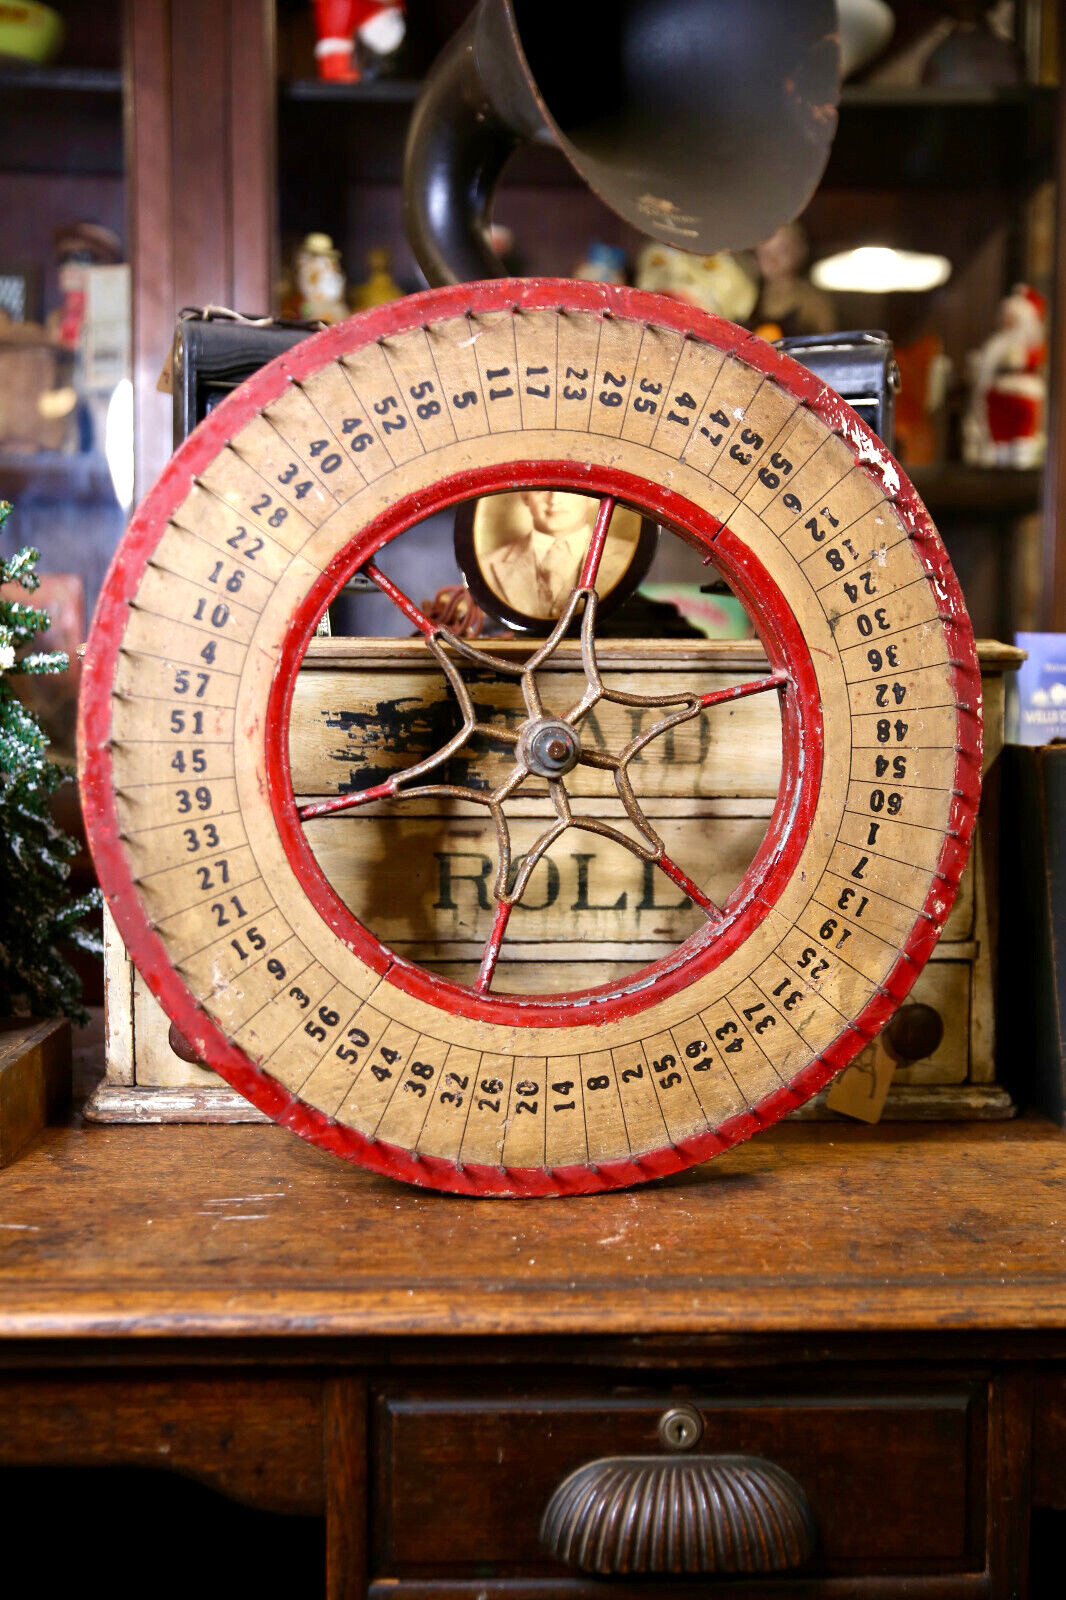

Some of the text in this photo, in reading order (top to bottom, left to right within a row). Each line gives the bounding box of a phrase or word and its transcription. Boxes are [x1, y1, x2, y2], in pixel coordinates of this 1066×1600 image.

[486, 367, 514, 401] 11
[526, 366, 550, 399] 17
[563, 367, 588, 401] 23
[599, 371, 627, 408] 29
[633, 378, 662, 415] 35
[374, 396, 406, 435] 52
[410, 381, 441, 420] 58
[452, 389, 478, 410] 5
[666, 392, 697, 427] 41
[341, 418, 373, 452] 46
[700, 409, 731, 447] 47
[310, 440, 342, 474] 40
[729, 428, 764, 466] 53
[278, 463, 313, 499] 34
[757, 452, 793, 490] 59
[252, 493, 287, 529] 28
[783, 493, 804, 514] 6
[804, 506, 840, 542] 12
[227, 525, 264, 561] 22
[825, 537, 859, 572] 18
[208, 562, 245, 593] 16
[843, 571, 877, 604] 24
[193, 598, 230, 629] 10
[856, 606, 891, 637] 30
[200, 640, 217, 666] 4
[867, 644, 898, 673] 36
[174, 670, 210, 698] 57
[875, 682, 907, 708] 42
[171, 710, 202, 735] 51
[876, 718, 909, 743] 48
[171, 749, 206, 773] 45
[875, 754, 907, 779] 54
[175, 786, 212, 813] 39
[869, 789, 902, 816] 60
[183, 823, 219, 852] 33
[867, 823, 880, 846] 1
[196, 860, 229, 891] 27
[433, 852, 693, 911] ROLL
[851, 856, 869, 880] 7
[211, 896, 247, 927] 21
[837, 887, 869, 918] 13
[230, 927, 266, 961] 15
[819, 918, 853, 948] 19
[266, 958, 287, 981] 9
[796, 947, 830, 980] 25
[289, 987, 310, 1009] 3
[772, 977, 804, 1012] 31
[304, 1006, 340, 1043] 56
[742, 1002, 776, 1035] 37
[335, 1027, 370, 1065] 50
[715, 1021, 744, 1054] 43
[370, 1046, 399, 1082] 44
[652, 1054, 682, 1090] 55
[685, 1040, 714, 1072] 49
[405, 1061, 435, 1098] 38
[439, 1072, 469, 1108] 32
[586, 1075, 610, 1091] 8
[621, 1063, 644, 1084] 2
[477, 1079, 504, 1113] 26
[515, 1081, 540, 1115] 20
[551, 1080, 576, 1112] 14
